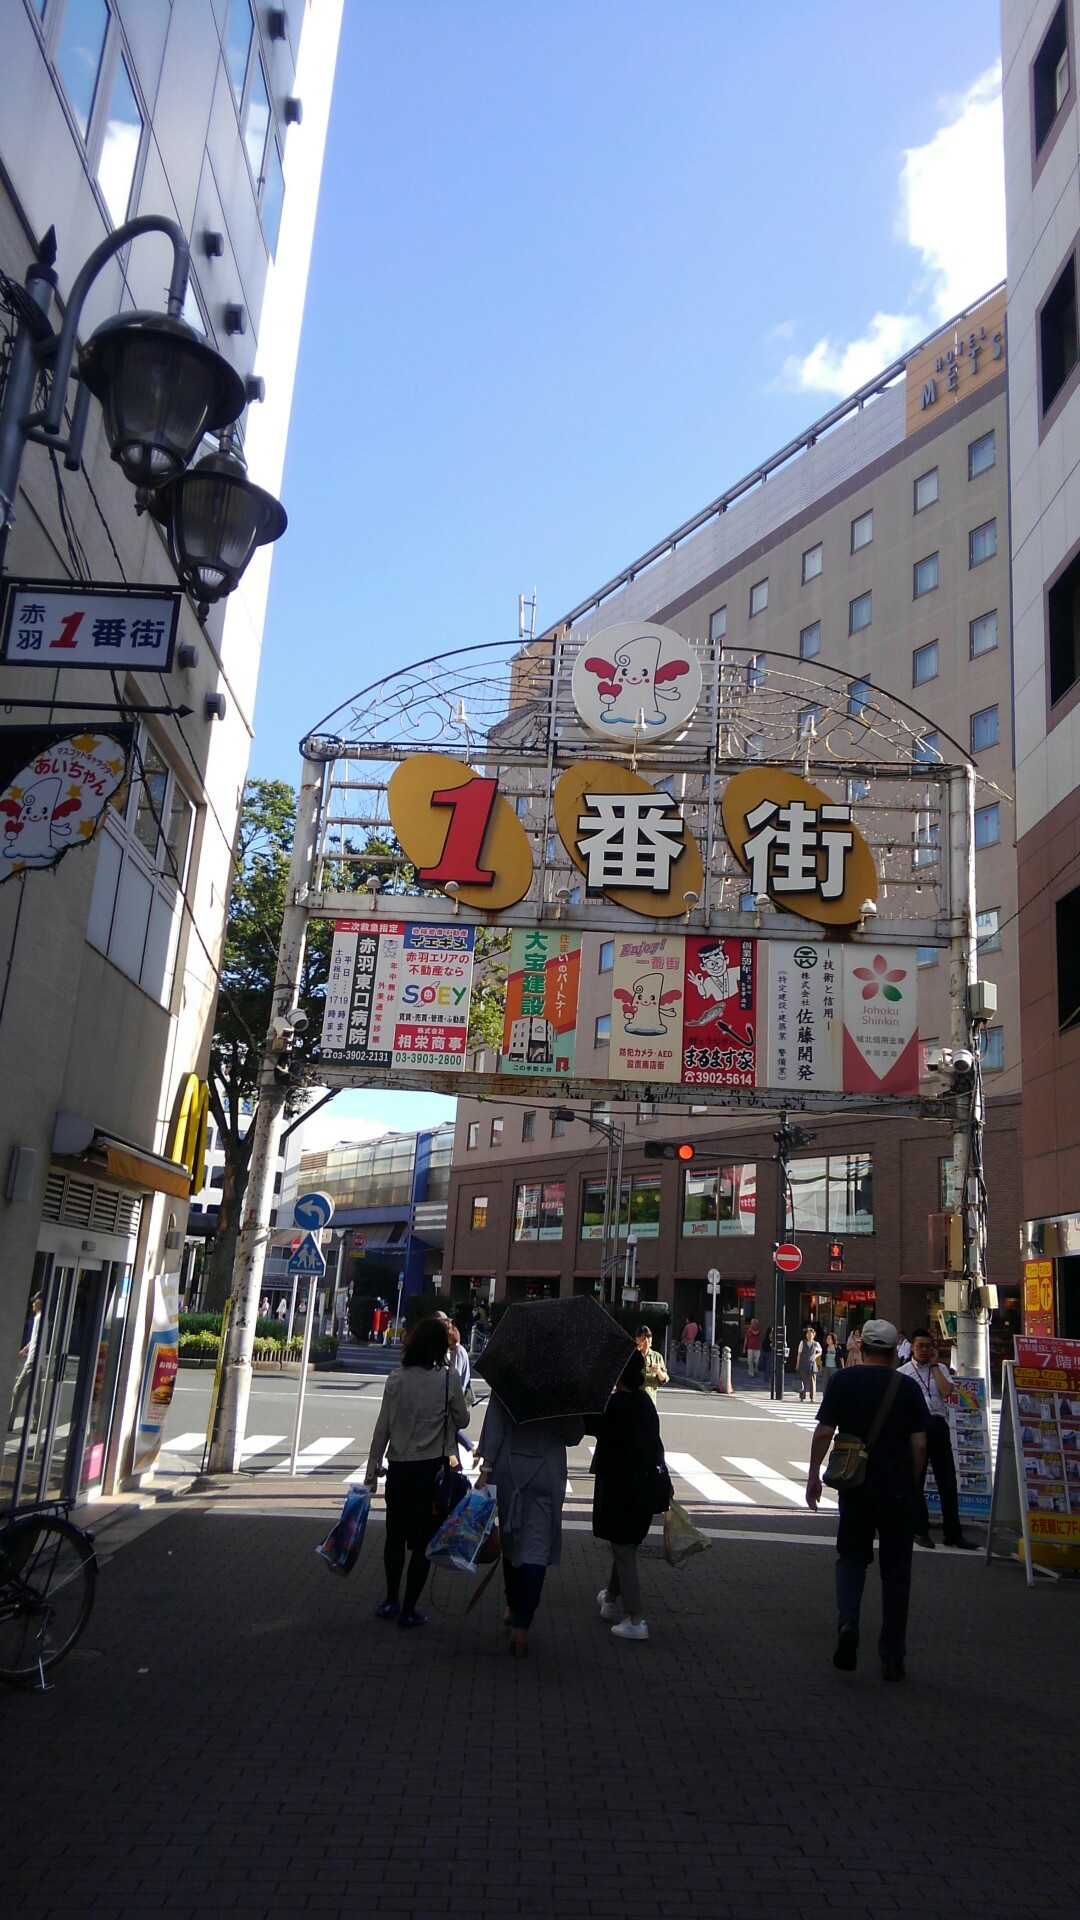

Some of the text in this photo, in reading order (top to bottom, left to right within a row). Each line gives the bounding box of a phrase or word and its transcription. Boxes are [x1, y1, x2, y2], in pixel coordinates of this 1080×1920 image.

[934, 327, 986, 372] HOTEL
[921, 332, 1002, 411] METS
[16, 604, 165, 650] 赤羽 1番街
[57, 747, 115, 778] マスコットキャラクター
[34, 757, 105, 797] あいちゃん
[341, 922, 398, 933] 二次救急指定
[411, 937, 467, 949] イエギメ
[406, 951, 469, 964] 赤羽エリアの
[636, 956, 680, 970] 一番街
[409, 965, 464, 977] 不動産なら
[521, 931, 548, 1018] 大宝建設
[555, 934, 570, 1018] 住まいのパートナー
[348, 937, 377, 1045] 赤羽東口病院
[386, 962, 398, 1002] 年中無休
[402, 984, 466, 1006] SOEY
[861, 1005, 899, 1016] Johoku
[796, 972, 815, 1081] 株式会社 佐藤開発
[862, 1015, 900, 1026] Shinkin
[397, 1034, 463, 1051] 相栄商事
[856, 1035, 905, 1045] 城北信用金庫
[332, 1050, 388, 1062] 03-3902-2131
[395, 1052, 462, 1066] 03-3903-2800
[684, 1046, 754, 1071] まるます家
[695, 1071, 752, 1085] 3902-5614
